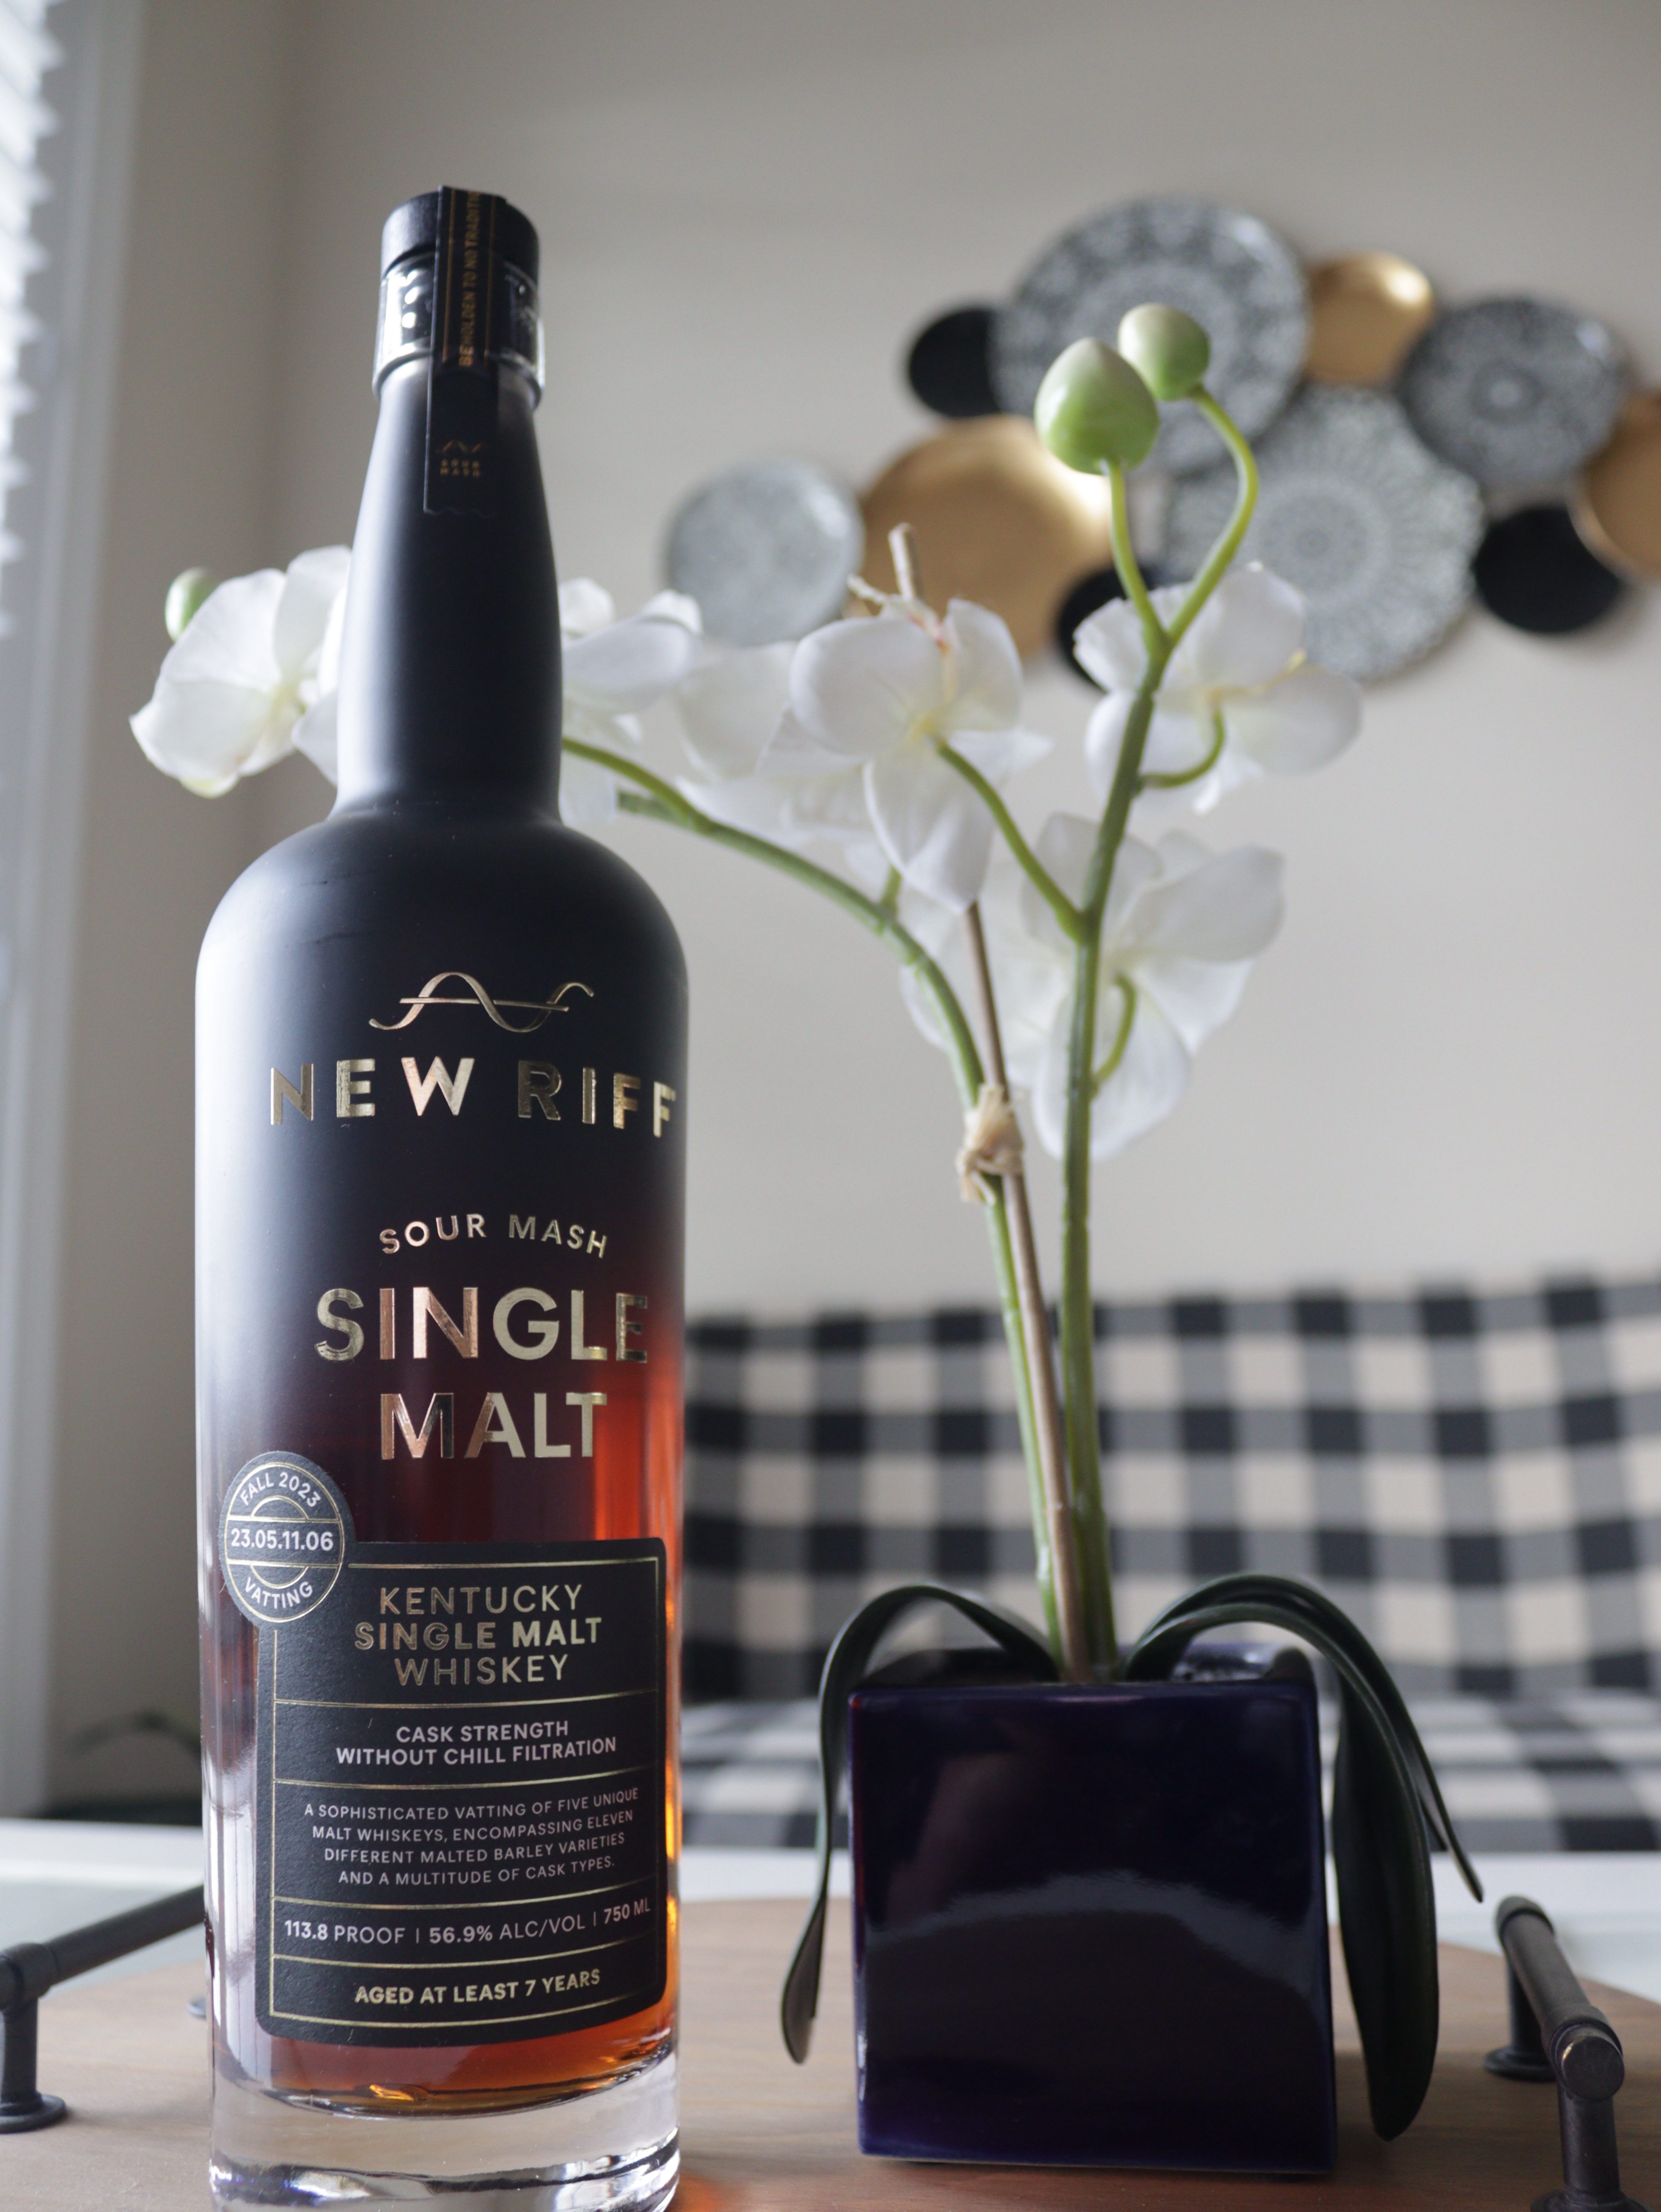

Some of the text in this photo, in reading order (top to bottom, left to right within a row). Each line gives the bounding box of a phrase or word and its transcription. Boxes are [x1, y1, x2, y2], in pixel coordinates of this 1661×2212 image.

[271, 1057, 676, 1138] NEW RIFF
[380, 1214, 608, 1259] SOUR MASH
[314, 1287, 648, 1363] SINGLE
[381, 1392, 608, 1460] MALT
[240, 1472, 321, 1507] FALL 2023
[231, 1528, 333, 1551] 23.05.11.06
[244, 1576, 313, 1609] VATTING
[380, 1584, 582, 1615] KENTUCKY
[355, 1617, 602, 1650] SINGLE MALT
[394, 1654, 568, 1686] WHISKEY
[396, 1720, 568, 1743] CASK STRENGTH
[336, 1737, 616, 1765] WITHOUT CHILL FILTRATION
[304, 1787, 639, 1820] A SOPHISTICATED VATTING OF FIVE UNIQUE
[312, 1809, 633, 1843] MALT WHISKEYS, ENCOMPASSING ELEVEN
[325, 1832, 625, 1863] DIFFERENT MALTED BARLEY VARIETIES
[338, 1855, 615, 1885] AND A MULTITUDE OF CASK TYPES.
[284, 1897, 651, 1944] 113.8 PROOF 56.9% ALC/VOL 750 ML
[355, 1968, 600, 2004] AGED AT LEAST 7 YEARS
